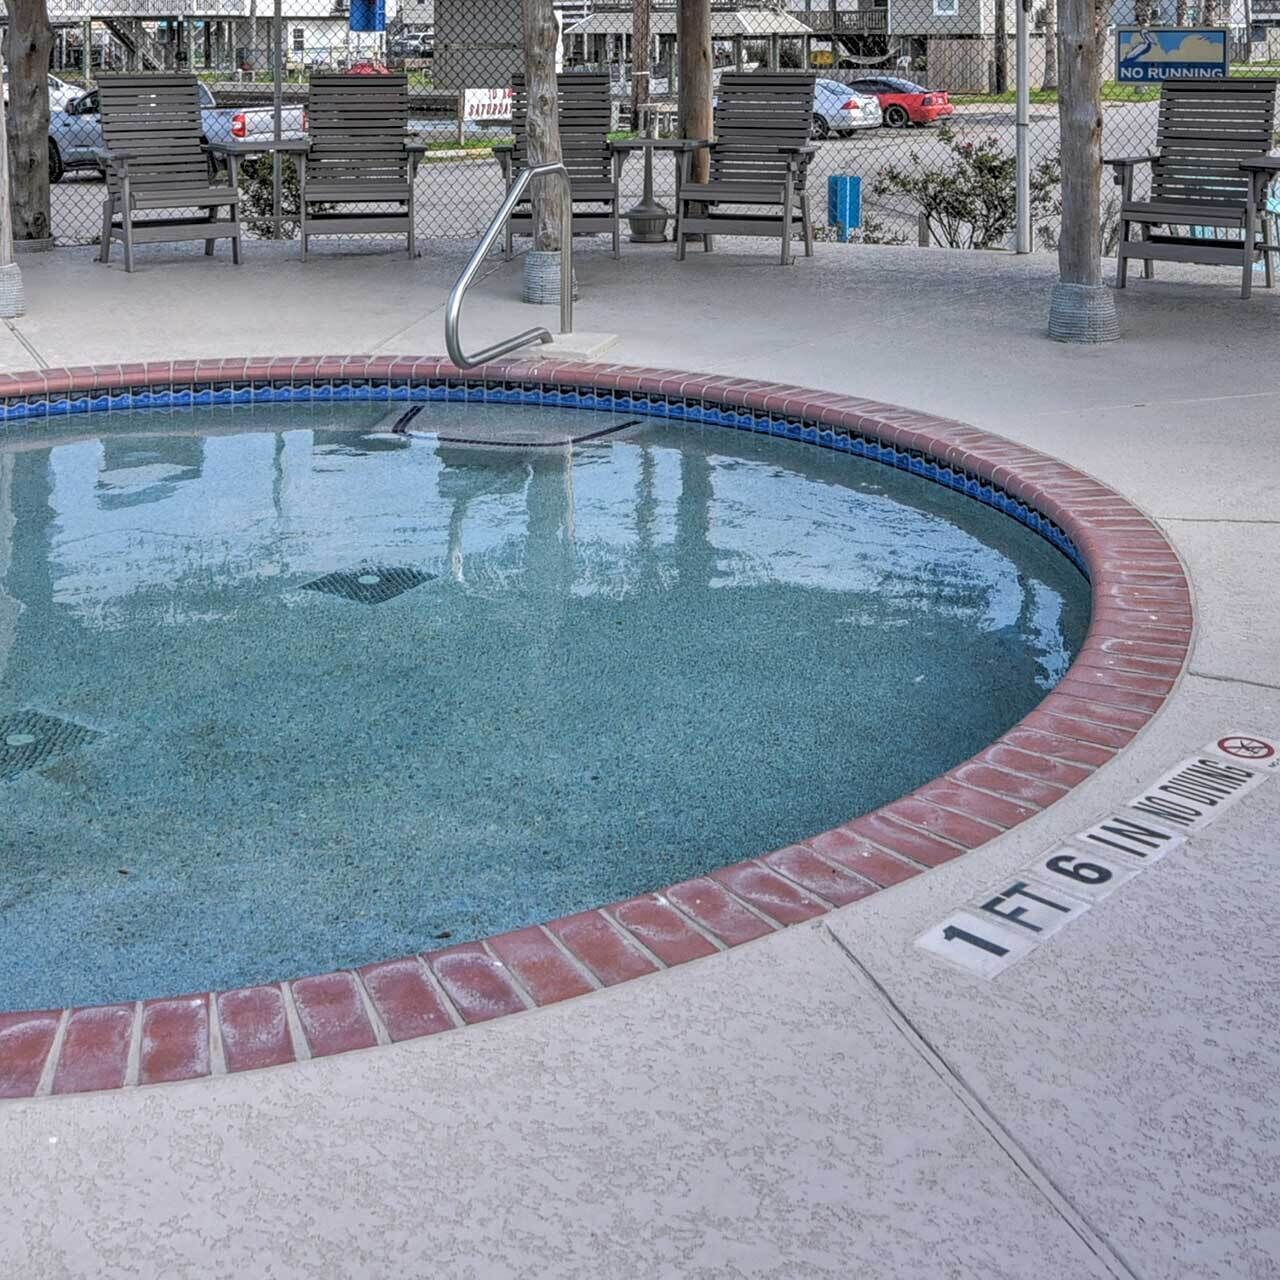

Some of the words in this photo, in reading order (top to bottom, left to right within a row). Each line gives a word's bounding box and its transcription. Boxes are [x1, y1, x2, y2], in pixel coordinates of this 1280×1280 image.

[1121, 67, 1144, 79] NO
[1148, 67, 1223, 79] RUNNING
[1158, 758, 1256, 807] DIVING
[1132, 795, 1203, 827] NO
[1087, 817, 1171, 858] IN
[1046, 854, 1113, 886] 6
[980, 881, 1071, 933] FT
[943, 924, 1010, 958] 1
